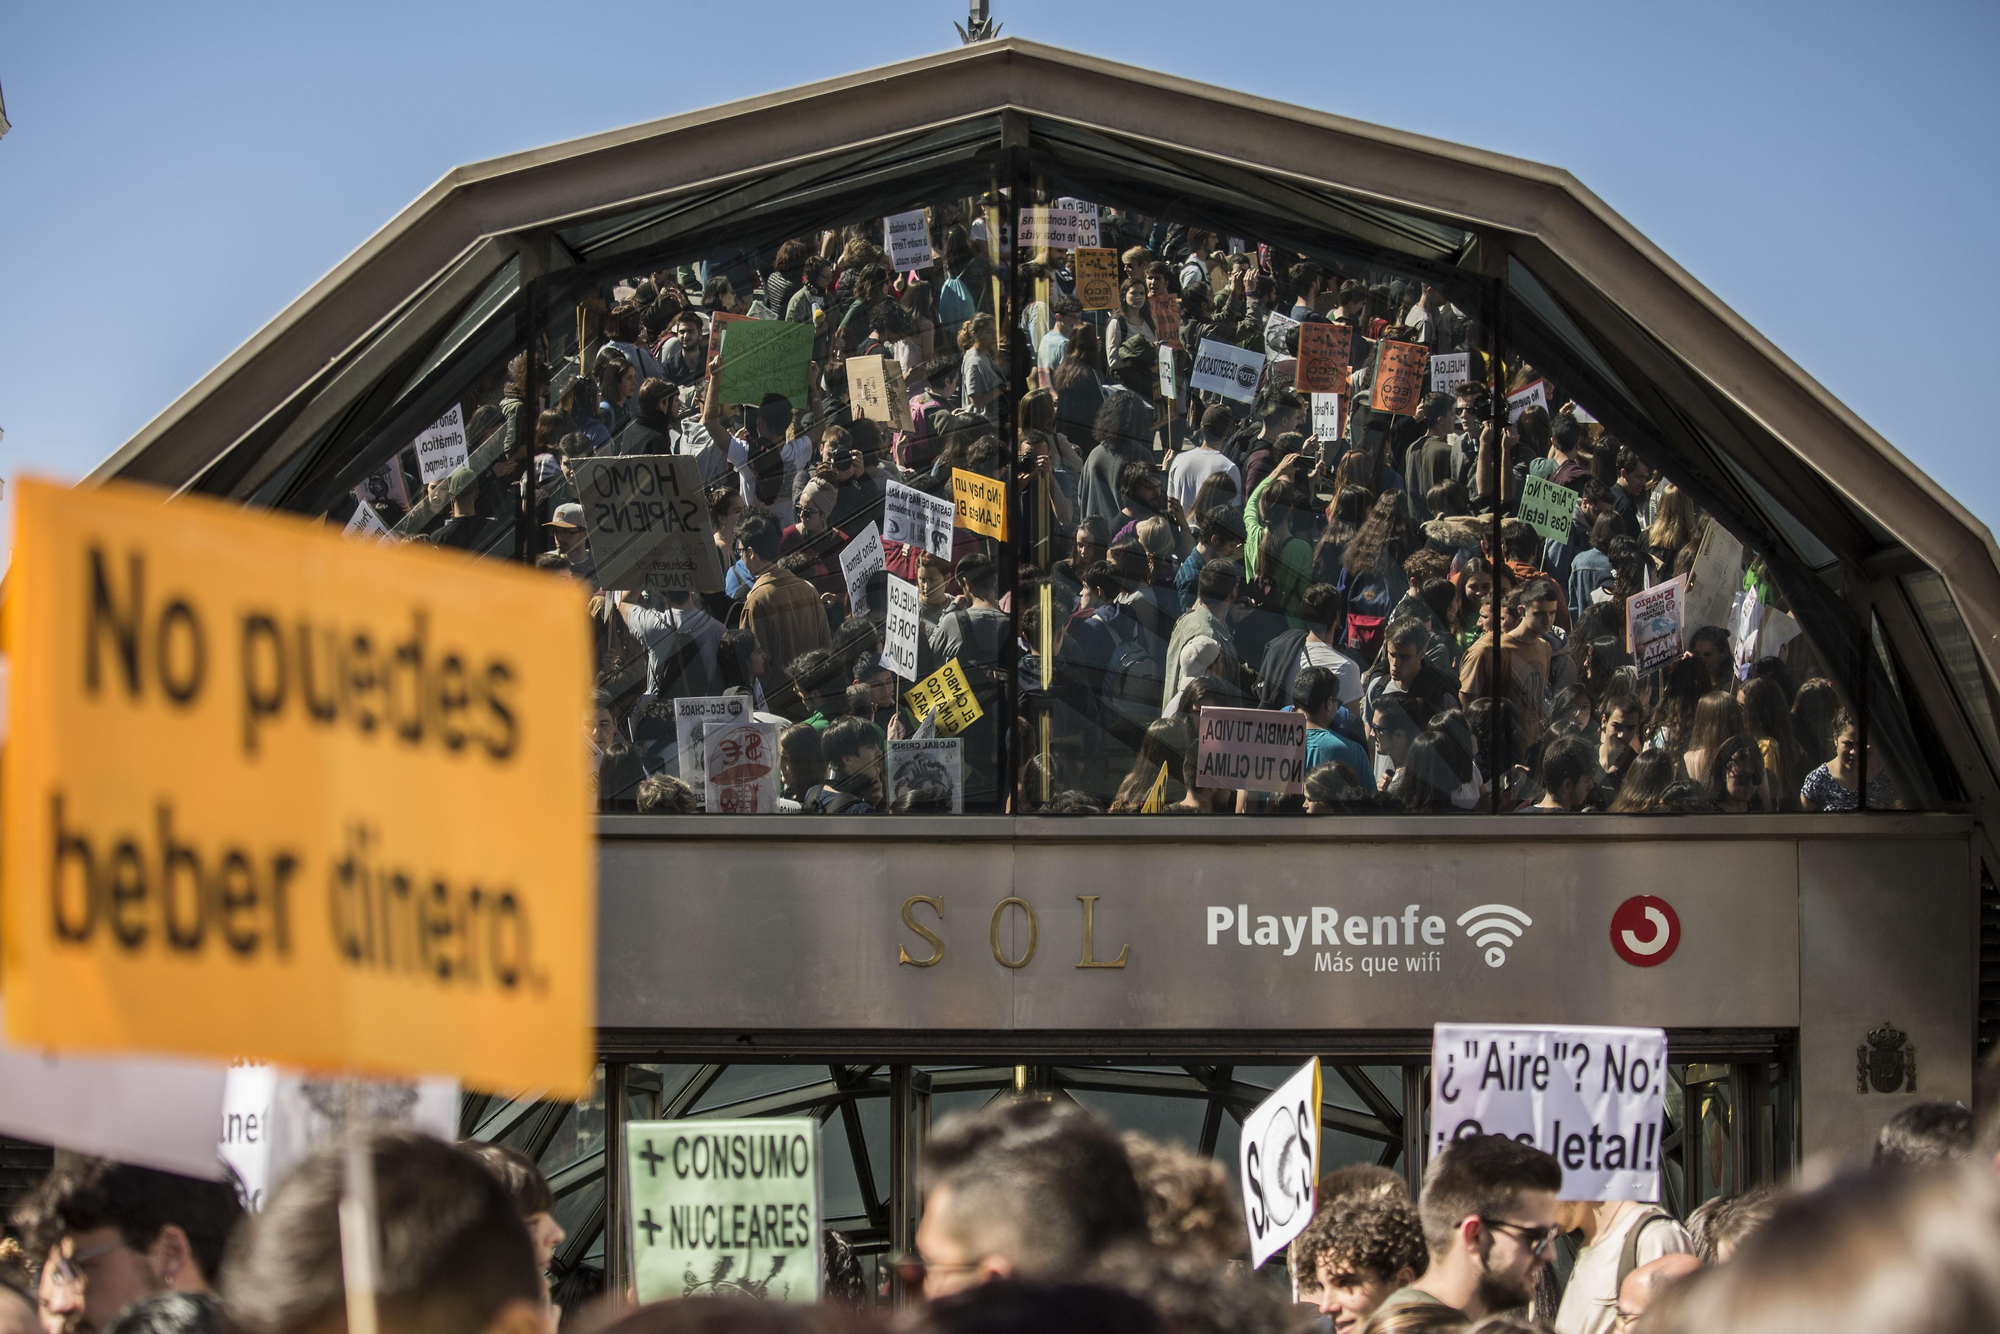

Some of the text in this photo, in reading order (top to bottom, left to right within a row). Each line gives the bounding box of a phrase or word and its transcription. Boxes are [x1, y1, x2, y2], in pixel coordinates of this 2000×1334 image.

[82, 545, 517, 760] No puedes
[50, 790, 550, 998] beber dinero.
[1207, 904, 1446, 956] PlayRenfe
[1314, 951, 1441, 977] Más que wifi
[1602, 1044, 1660, 1096] No:
[673, 1135, 809, 1179] CONSUMO
[1552, 1120, 1657, 1171] letal!
[670, 1204, 809, 1250] NUCLEARES
